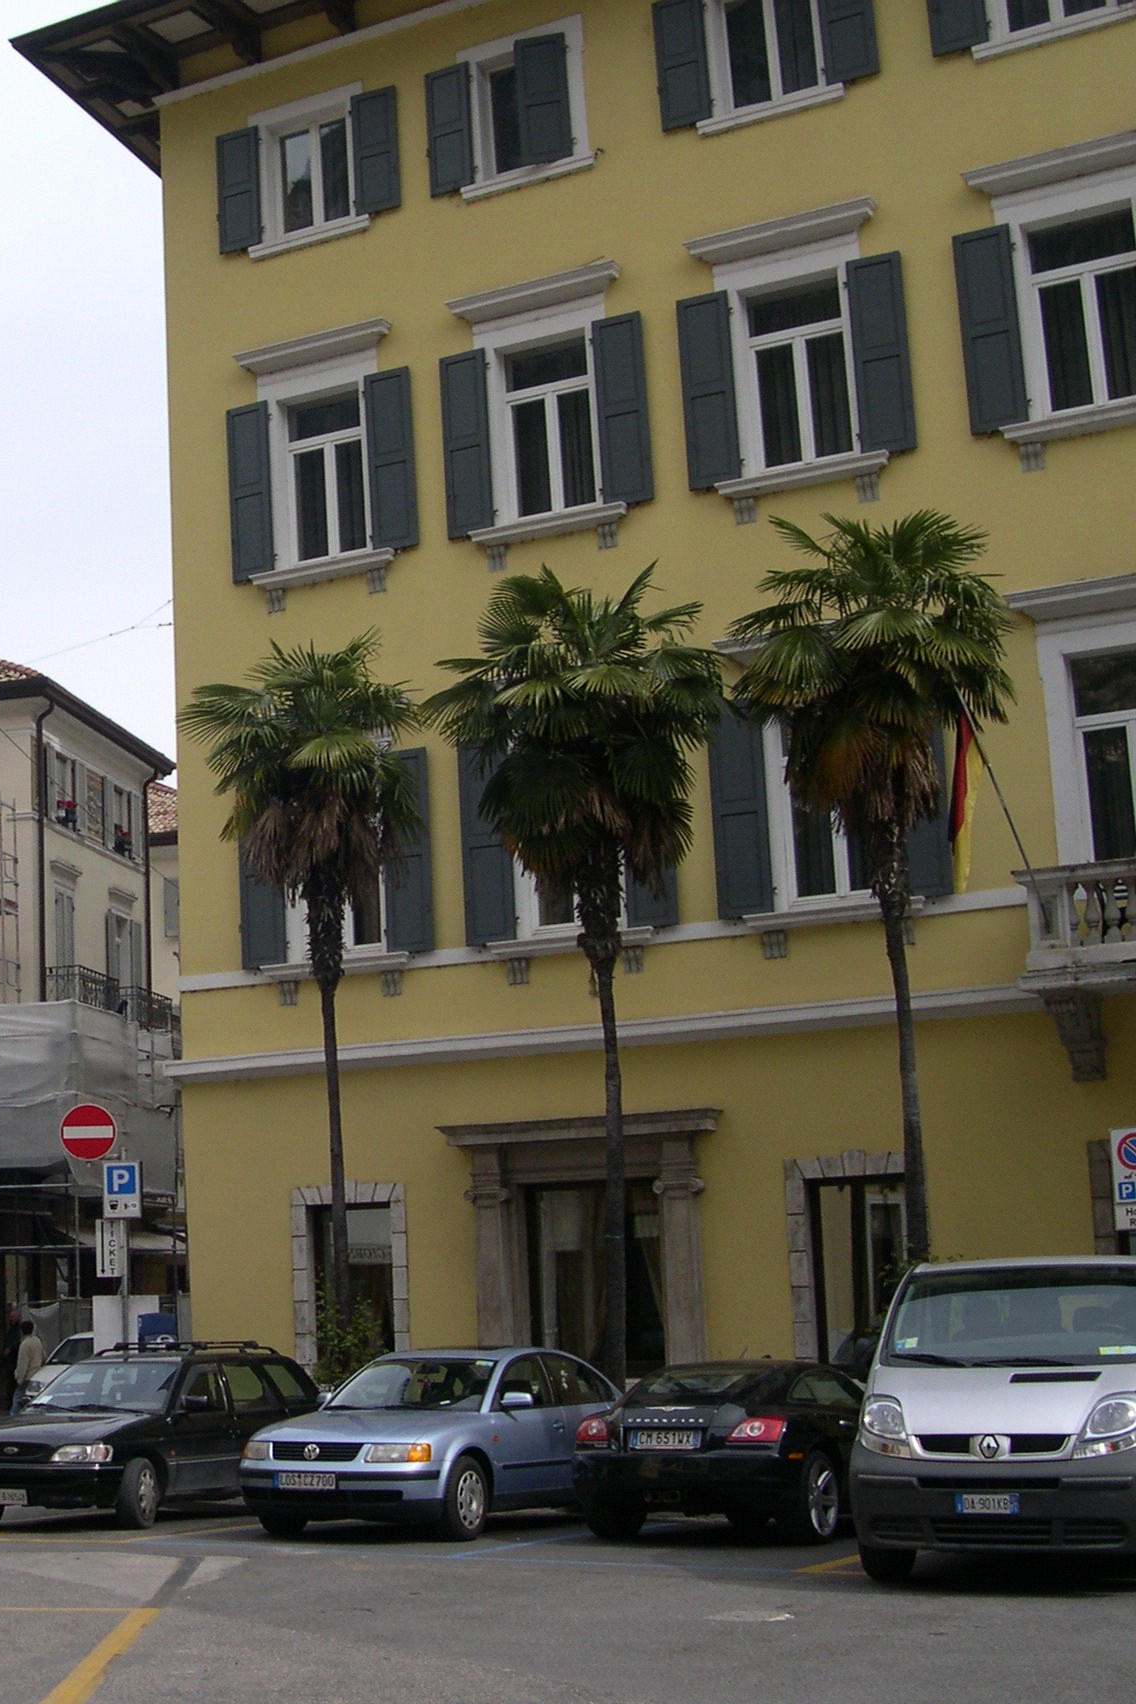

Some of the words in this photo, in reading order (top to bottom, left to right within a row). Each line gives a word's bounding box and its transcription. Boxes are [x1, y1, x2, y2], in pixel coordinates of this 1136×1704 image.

[113, 1170, 129, 1192] P
[1122, 1184, 1133, 1198] P
[108, 1221, 117, 1275] TICKET
